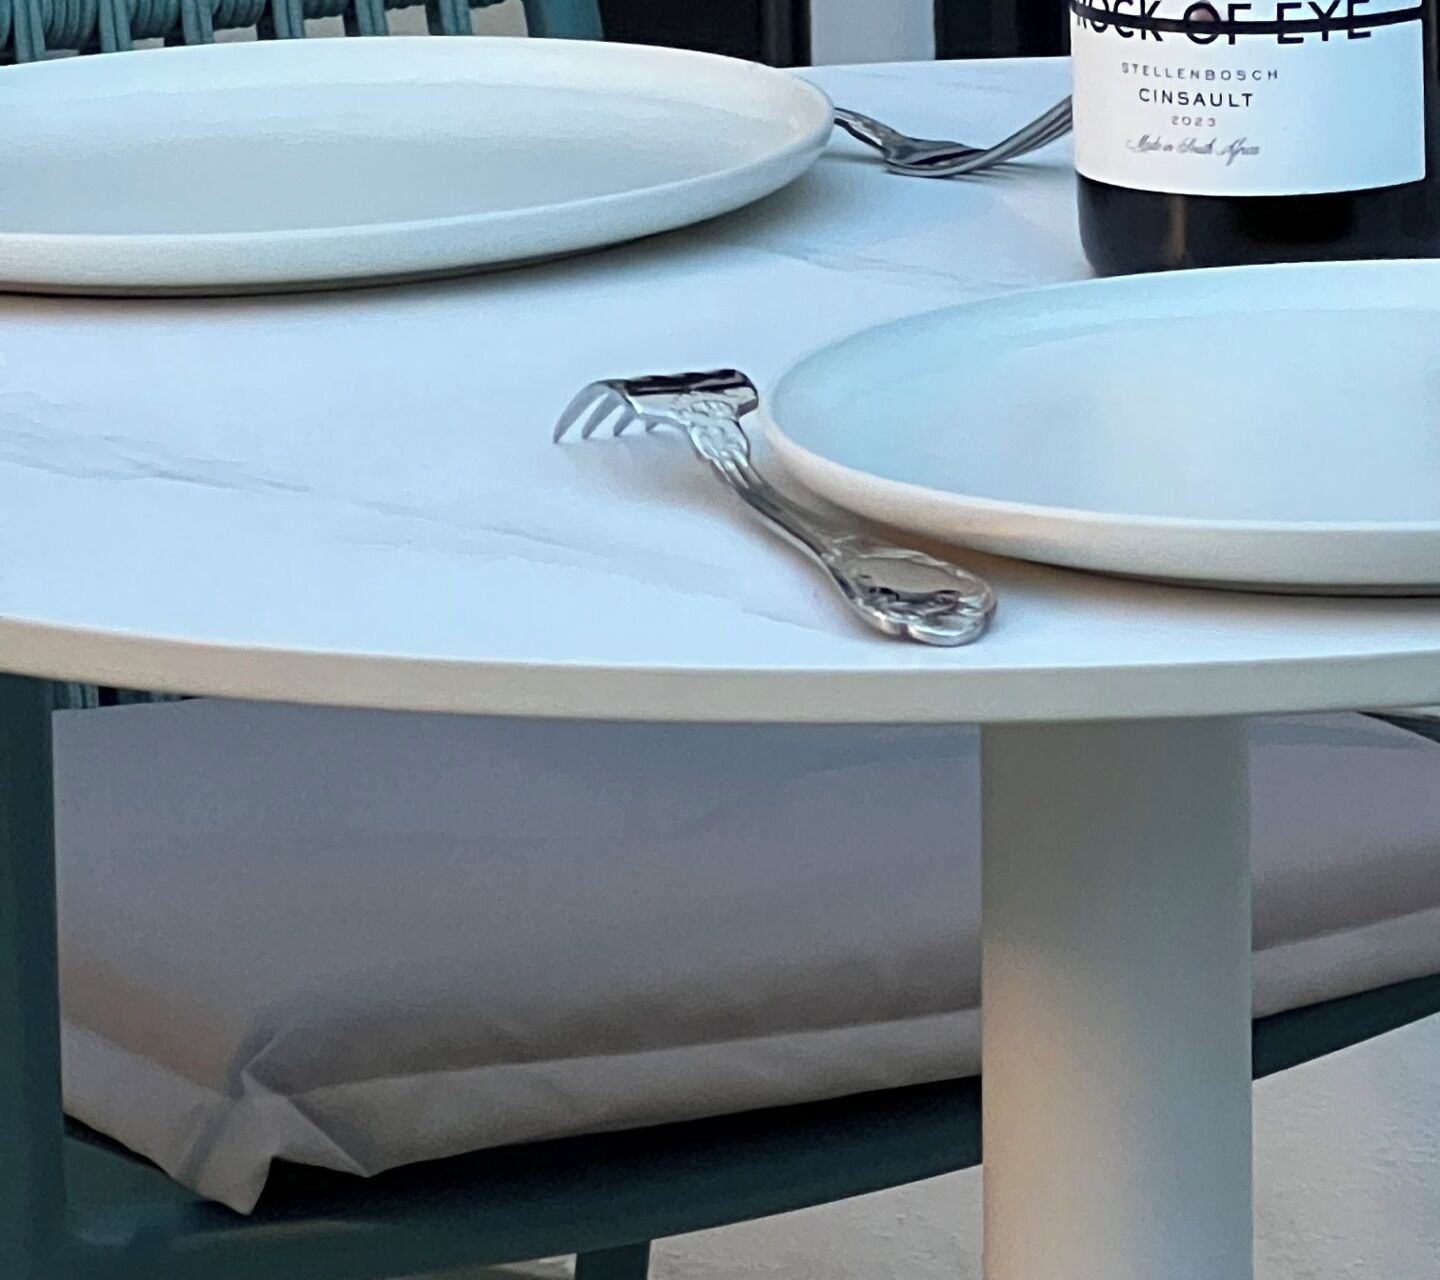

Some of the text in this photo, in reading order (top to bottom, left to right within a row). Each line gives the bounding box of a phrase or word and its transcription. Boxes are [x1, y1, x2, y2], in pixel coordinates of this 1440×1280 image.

[1183, 1, 1252, 45] OF
[1121, 61, 1279, 81] STELLENBOSCH
[1138, 87, 1254, 108] CINSAULT
[1171, 114, 1217, 128] 2023
